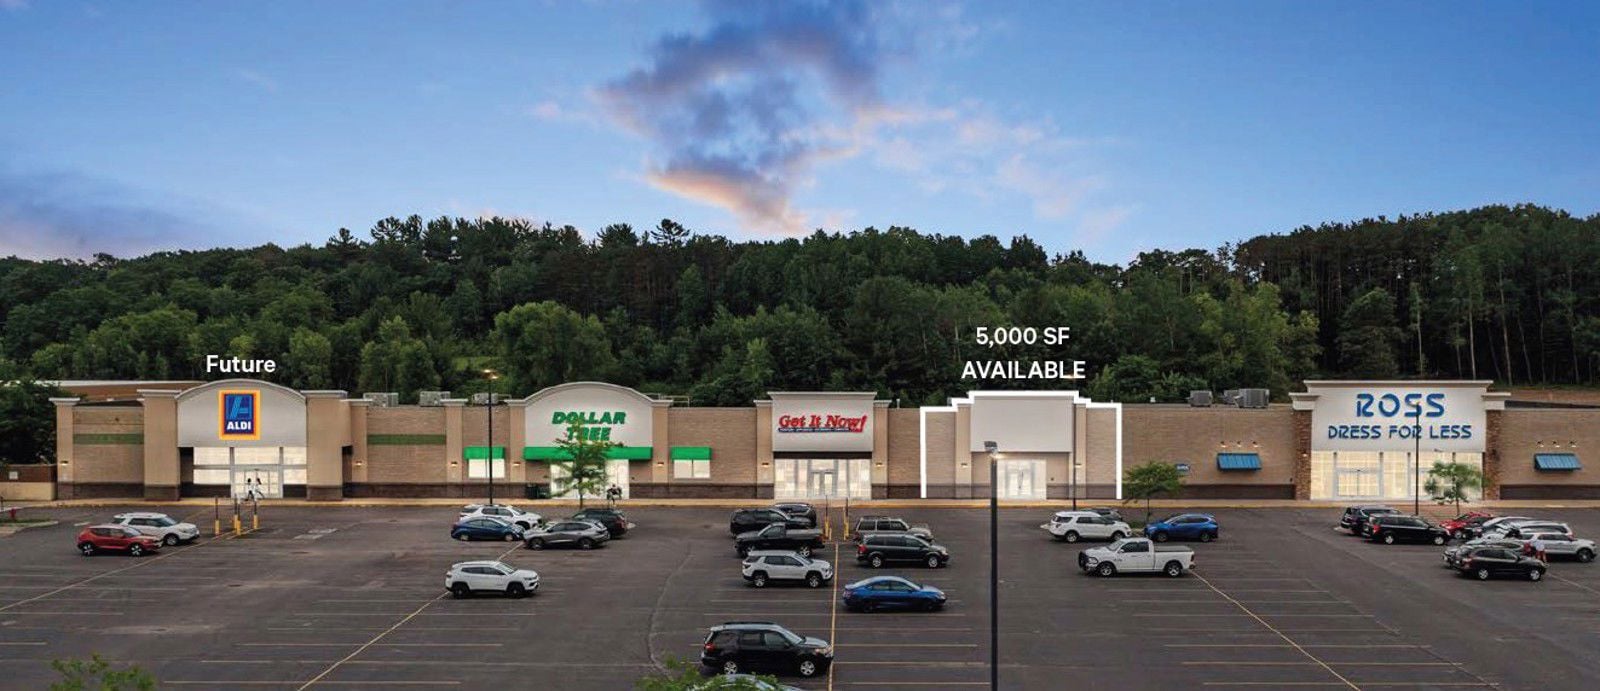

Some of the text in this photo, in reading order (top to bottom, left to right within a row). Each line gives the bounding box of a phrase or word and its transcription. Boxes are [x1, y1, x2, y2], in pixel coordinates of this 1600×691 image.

[1356, 393, 1445, 417] ROSS
[552, 411, 626, 424] DOLLAR
[779, 415, 806, 428] Get
[809, 415, 821, 428] It
[226, 421, 251, 430] ALDI
[1328, 425, 1472, 439] DRESS FOR LESS
